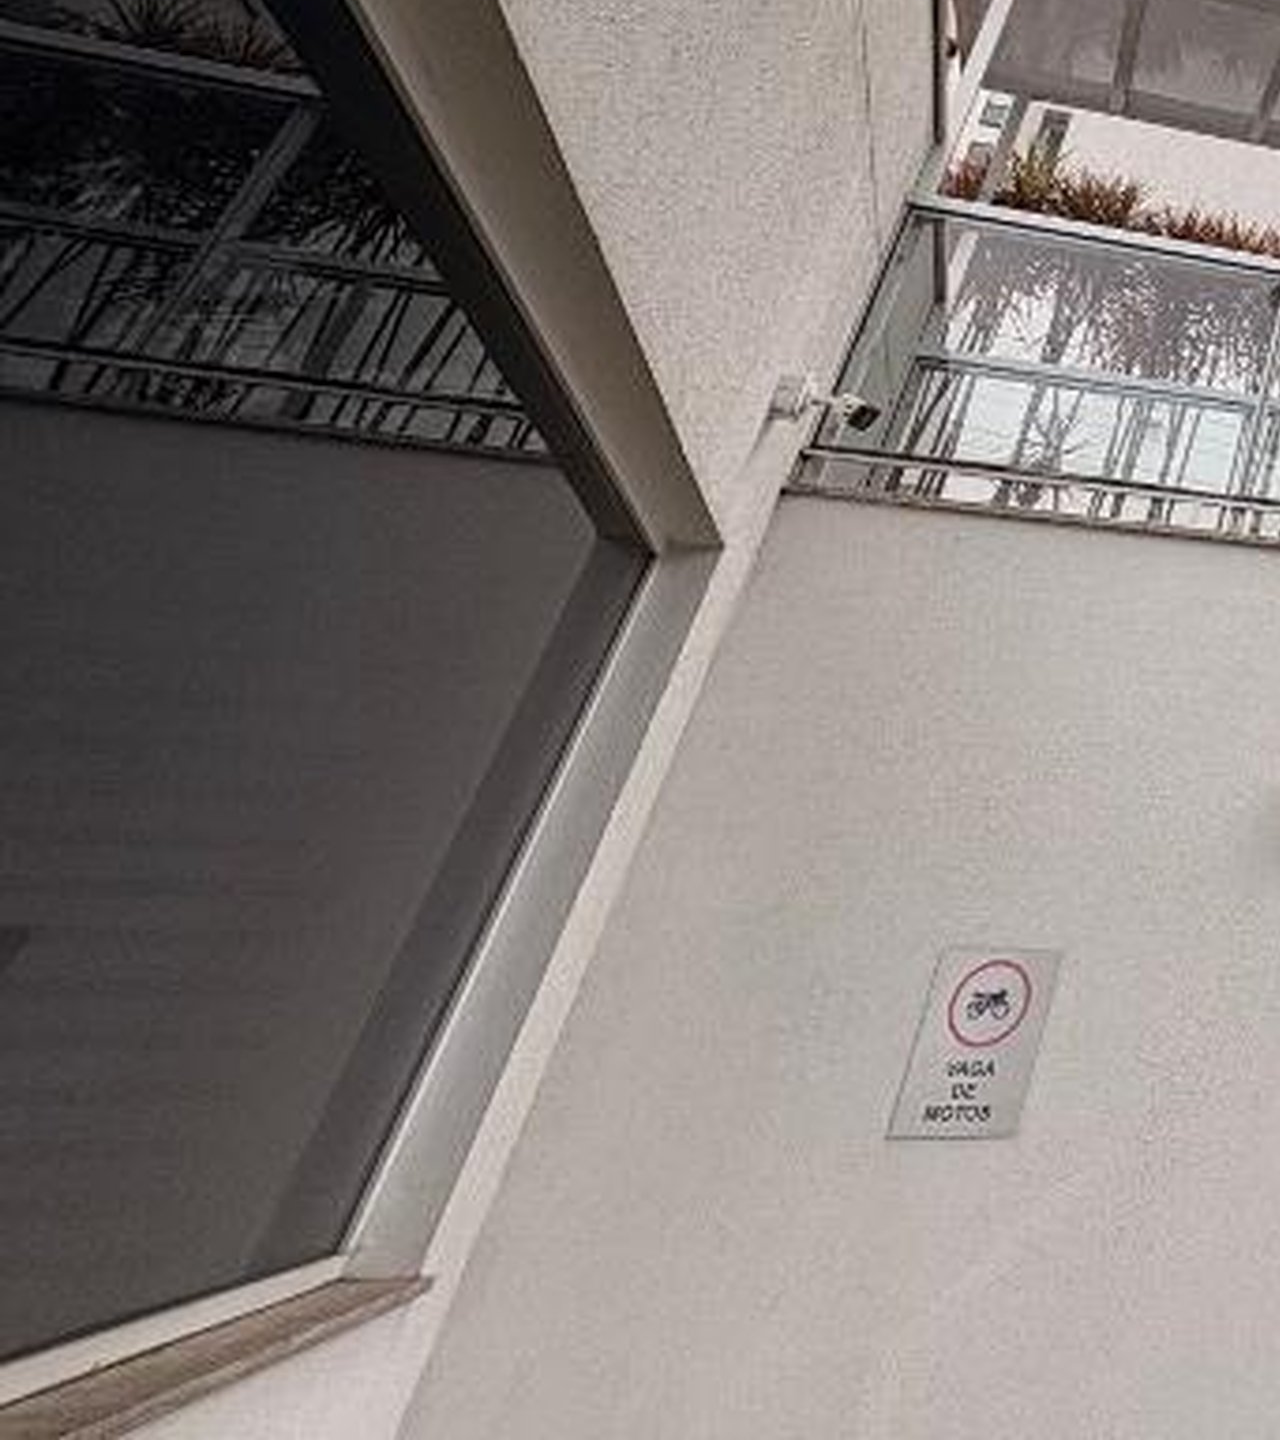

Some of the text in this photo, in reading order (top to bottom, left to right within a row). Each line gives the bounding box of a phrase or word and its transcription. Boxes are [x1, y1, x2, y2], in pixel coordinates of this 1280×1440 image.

[947, 1060, 995, 1077] VAGA
[951, 1083, 978, 1100] DE
[922, 1105, 991, 1122] MOTOS
